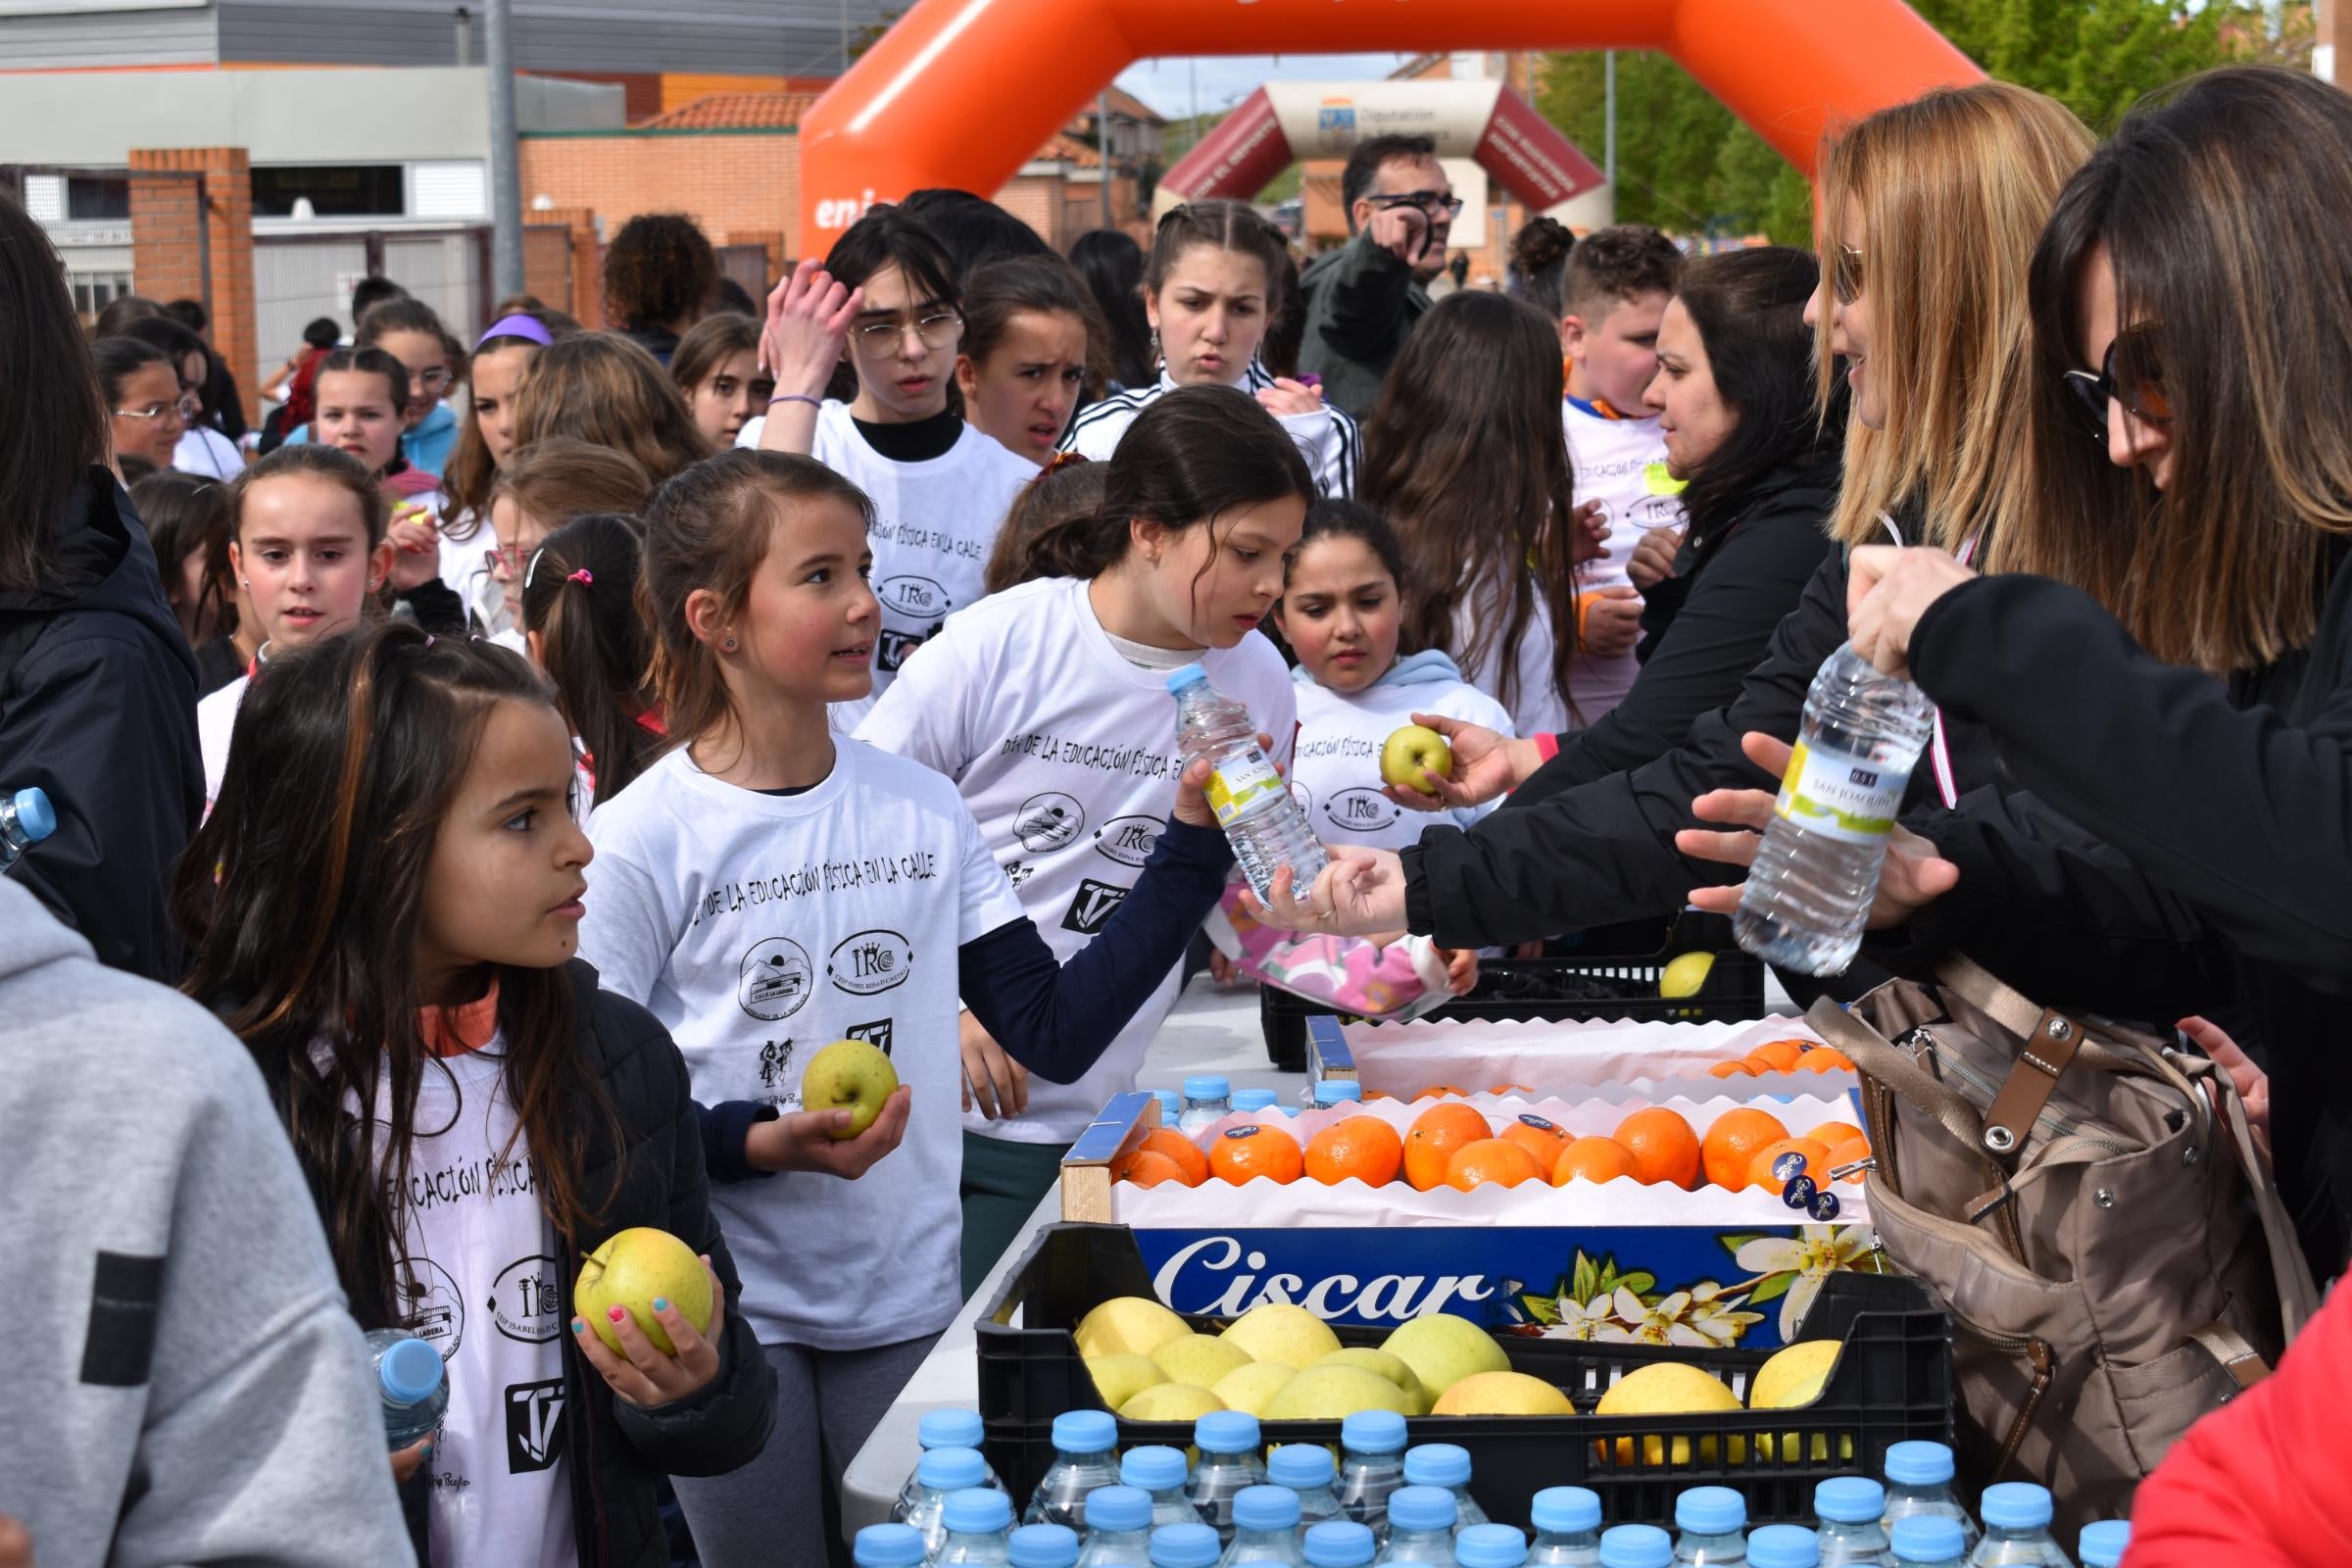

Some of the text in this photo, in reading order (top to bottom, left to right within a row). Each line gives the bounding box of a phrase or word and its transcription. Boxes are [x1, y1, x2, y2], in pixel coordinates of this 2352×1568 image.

[1023, 735, 1042, 757] DE
[1041, 735, 1059, 763] LA
[1062, 742, 1133, 771] EDUCACIÓN
[1129, 747, 1168, 780] FÍSICA
[1341, 734, 1374, 759] FÍSICA
[706, 891, 724, 917] DE
[726, 883, 748, 912] LA
[749, 863, 821, 906] EDUCACIÓN
[823, 859, 865, 894] FÍSICA
[864, 860, 881, 883] EN
[881, 857, 901, 883] LA
[902, 852, 936, 879] CALLE
[387, 1154, 481, 1210] ECACIÓN
[1152, 1235, 1495, 1321] Ciscar
[418, 1325, 444, 1339] LADERA
[510, 1322, 535, 1334] ISABEL
[441, 1335, 462, 1363] AGRADA
